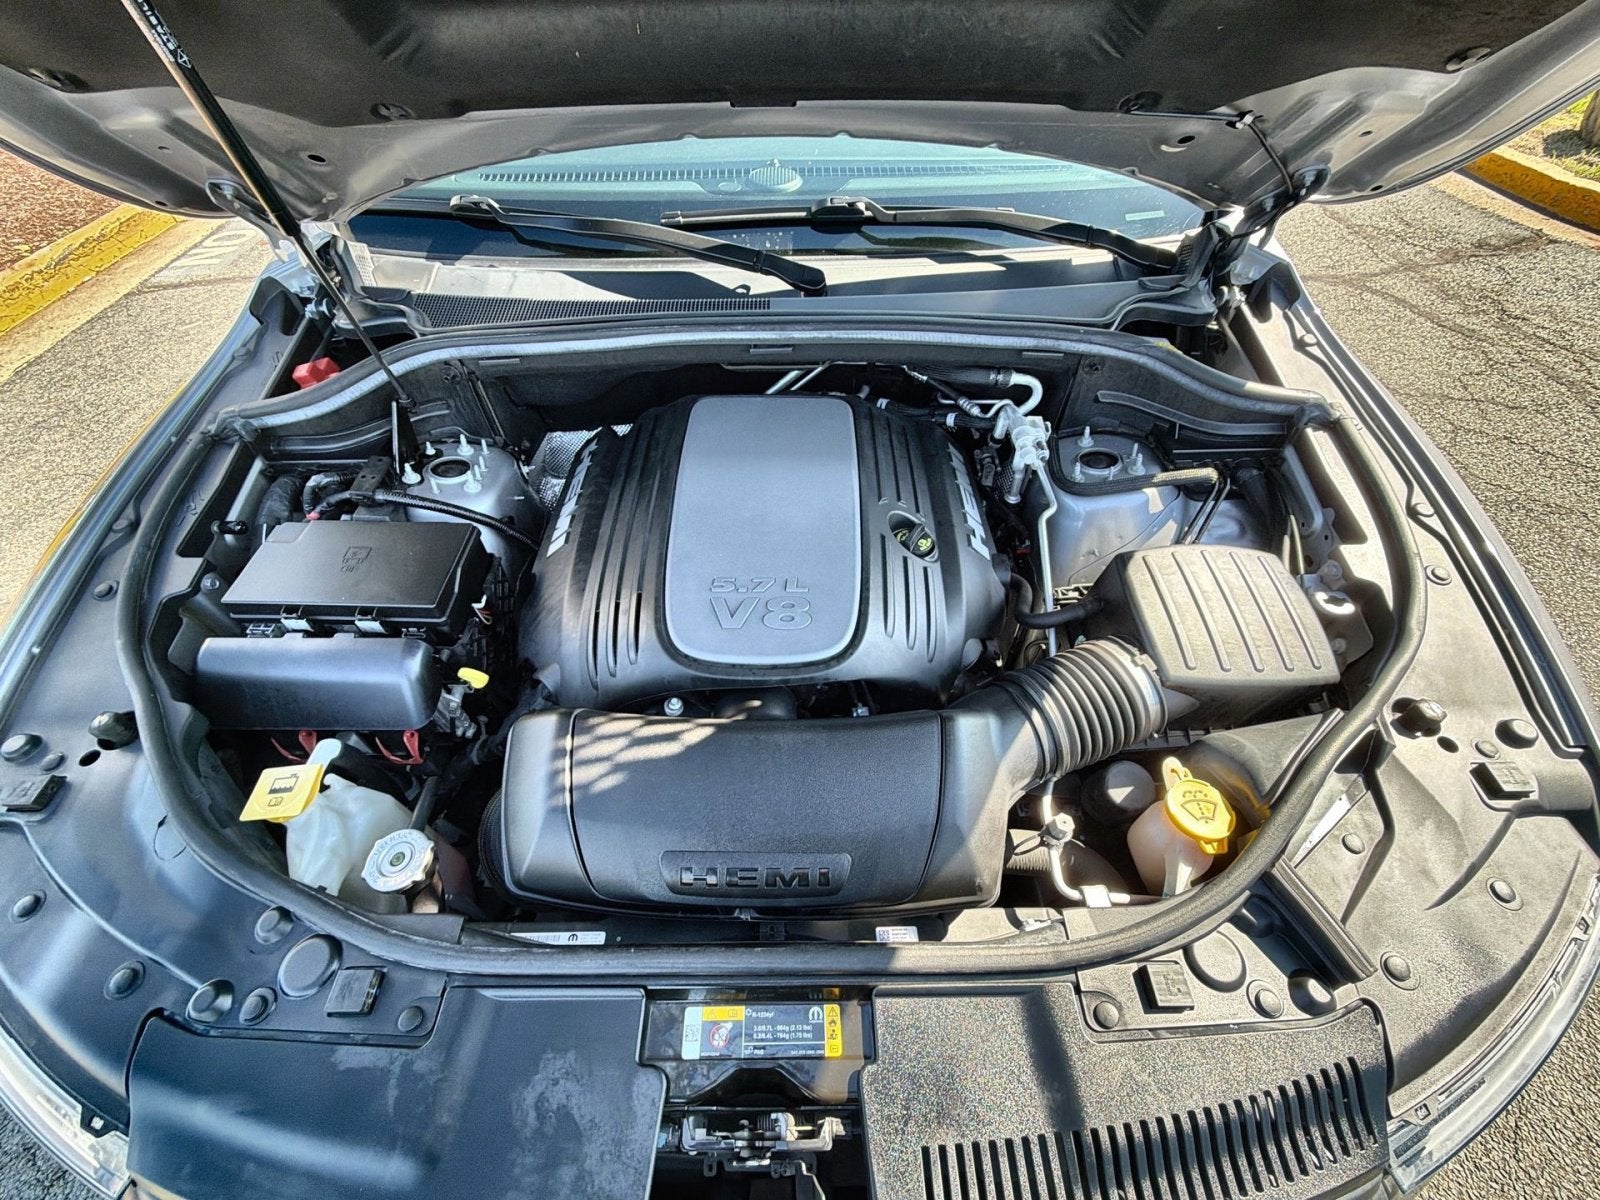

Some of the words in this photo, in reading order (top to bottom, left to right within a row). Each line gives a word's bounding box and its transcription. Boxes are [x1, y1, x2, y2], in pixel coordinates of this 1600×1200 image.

[178, 229, 257, 267] NO
[709, 597, 813, 630] V8
[680, 866, 831, 888] HEMI
